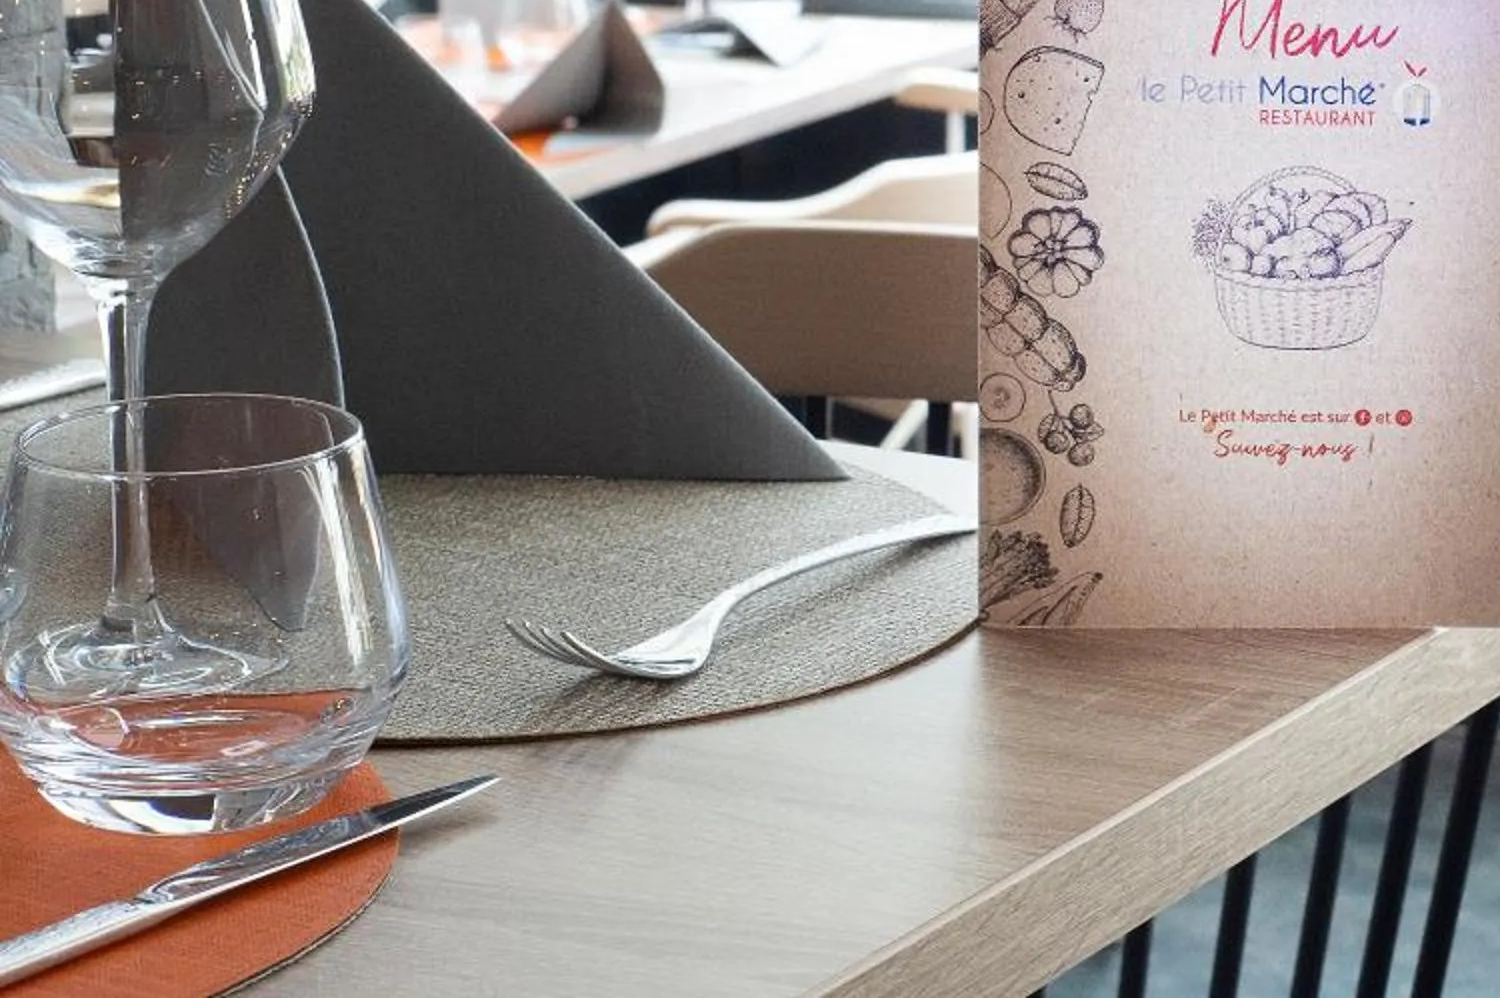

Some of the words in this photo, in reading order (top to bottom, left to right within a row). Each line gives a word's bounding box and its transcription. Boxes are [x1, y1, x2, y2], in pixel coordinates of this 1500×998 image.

[1141, 75, 1166, 103] le
[1180, 75, 1247, 103] Petit
[1259, 75, 1376, 105] Marché
[1259, 109, 1376, 126] RESTAURANT
[1179, 409, 1197, 423] Le
[1201, 409, 1236, 423] Petit
[1241, 409, 1297, 423] Marché
[1301, 411, 1324, 423] est
[1328, 412, 1350, 423] sur
[1375, 410, 1392, 424] et
